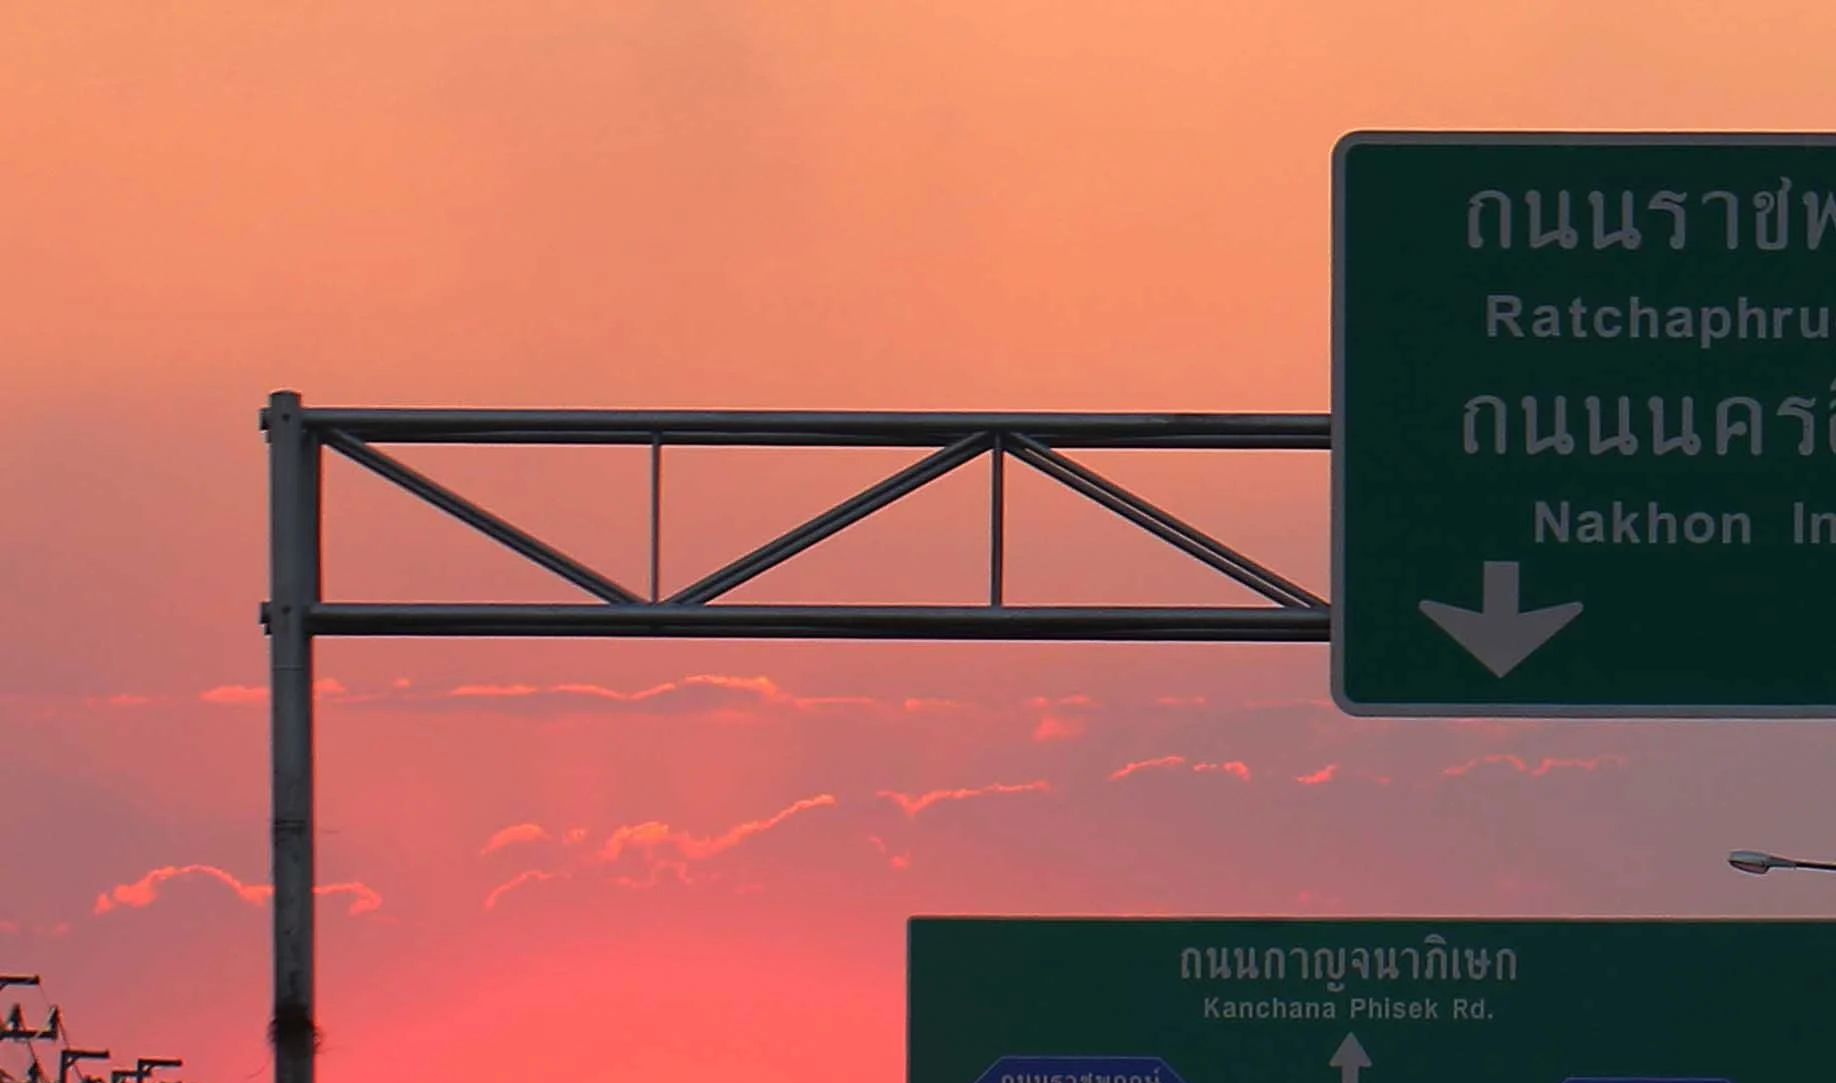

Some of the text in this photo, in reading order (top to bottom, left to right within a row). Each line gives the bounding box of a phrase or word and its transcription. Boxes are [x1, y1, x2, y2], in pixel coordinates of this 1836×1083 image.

[1486, 295, 1830, 350] Ratchaphru
[1463, 379, 1836, 456] ถนนนคร
[1534, 501, 1752, 545] Nakhon
[1180, 933, 1518, 993] ถนนกาญจนาภิเษก
[1203, 997, 1495, 1020] Kanchana Phisek Rd.
